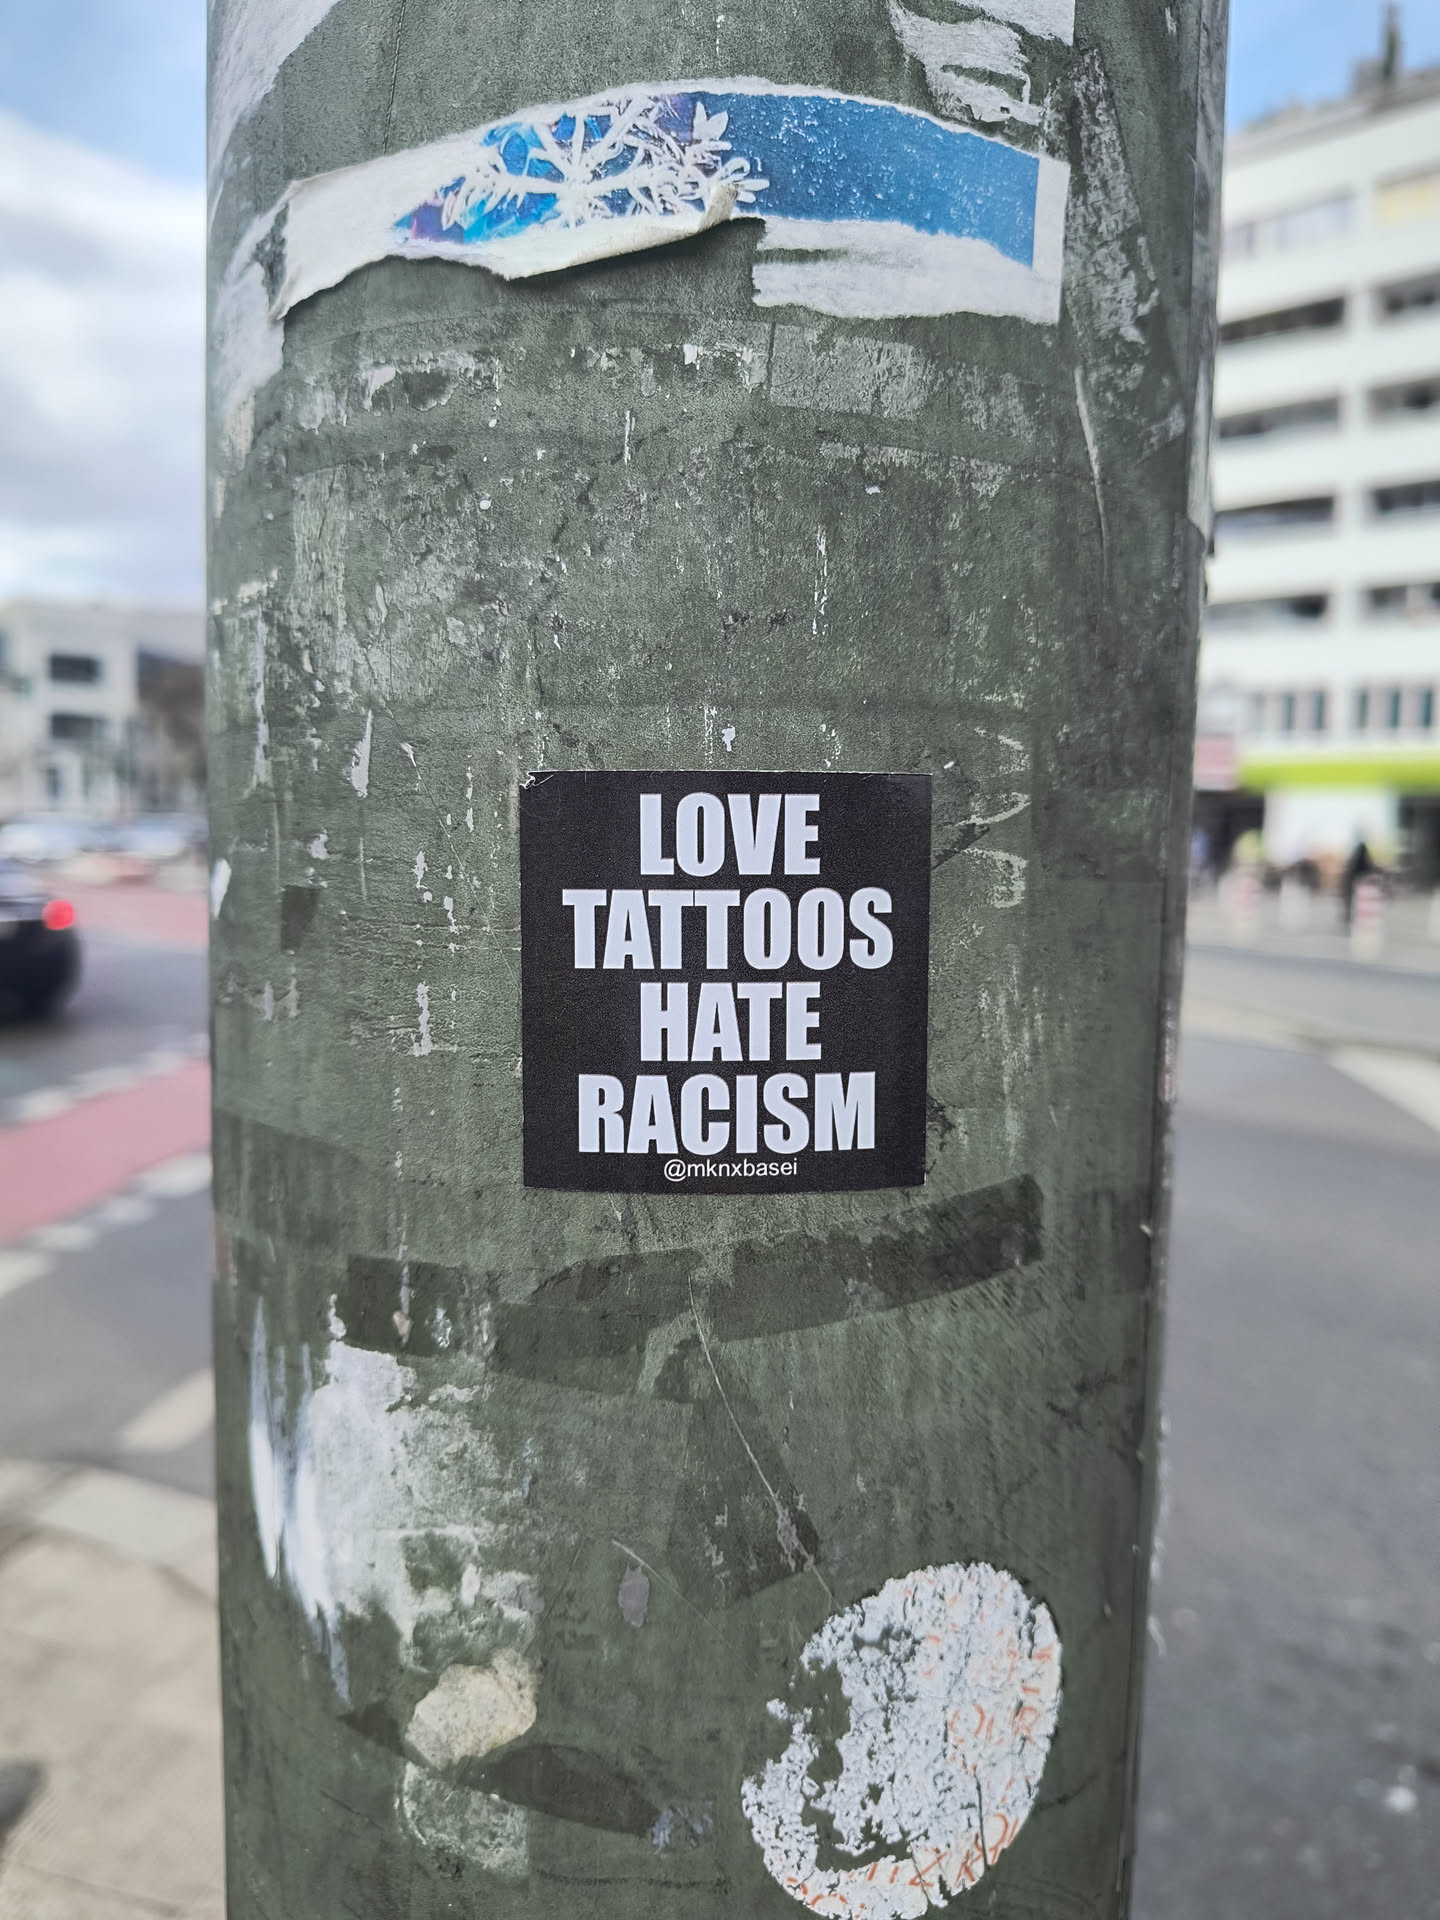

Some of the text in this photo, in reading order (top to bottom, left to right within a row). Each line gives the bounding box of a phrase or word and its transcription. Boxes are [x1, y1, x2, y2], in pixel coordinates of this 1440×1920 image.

[640, 792, 821, 877] LOVE
[562, 887, 894, 970] TATTOOS
[640, 981, 822, 1062] HATE
[578, 1072, 876, 1155] RACISM
[663, 1158, 798, 1182] @mknxbasei
